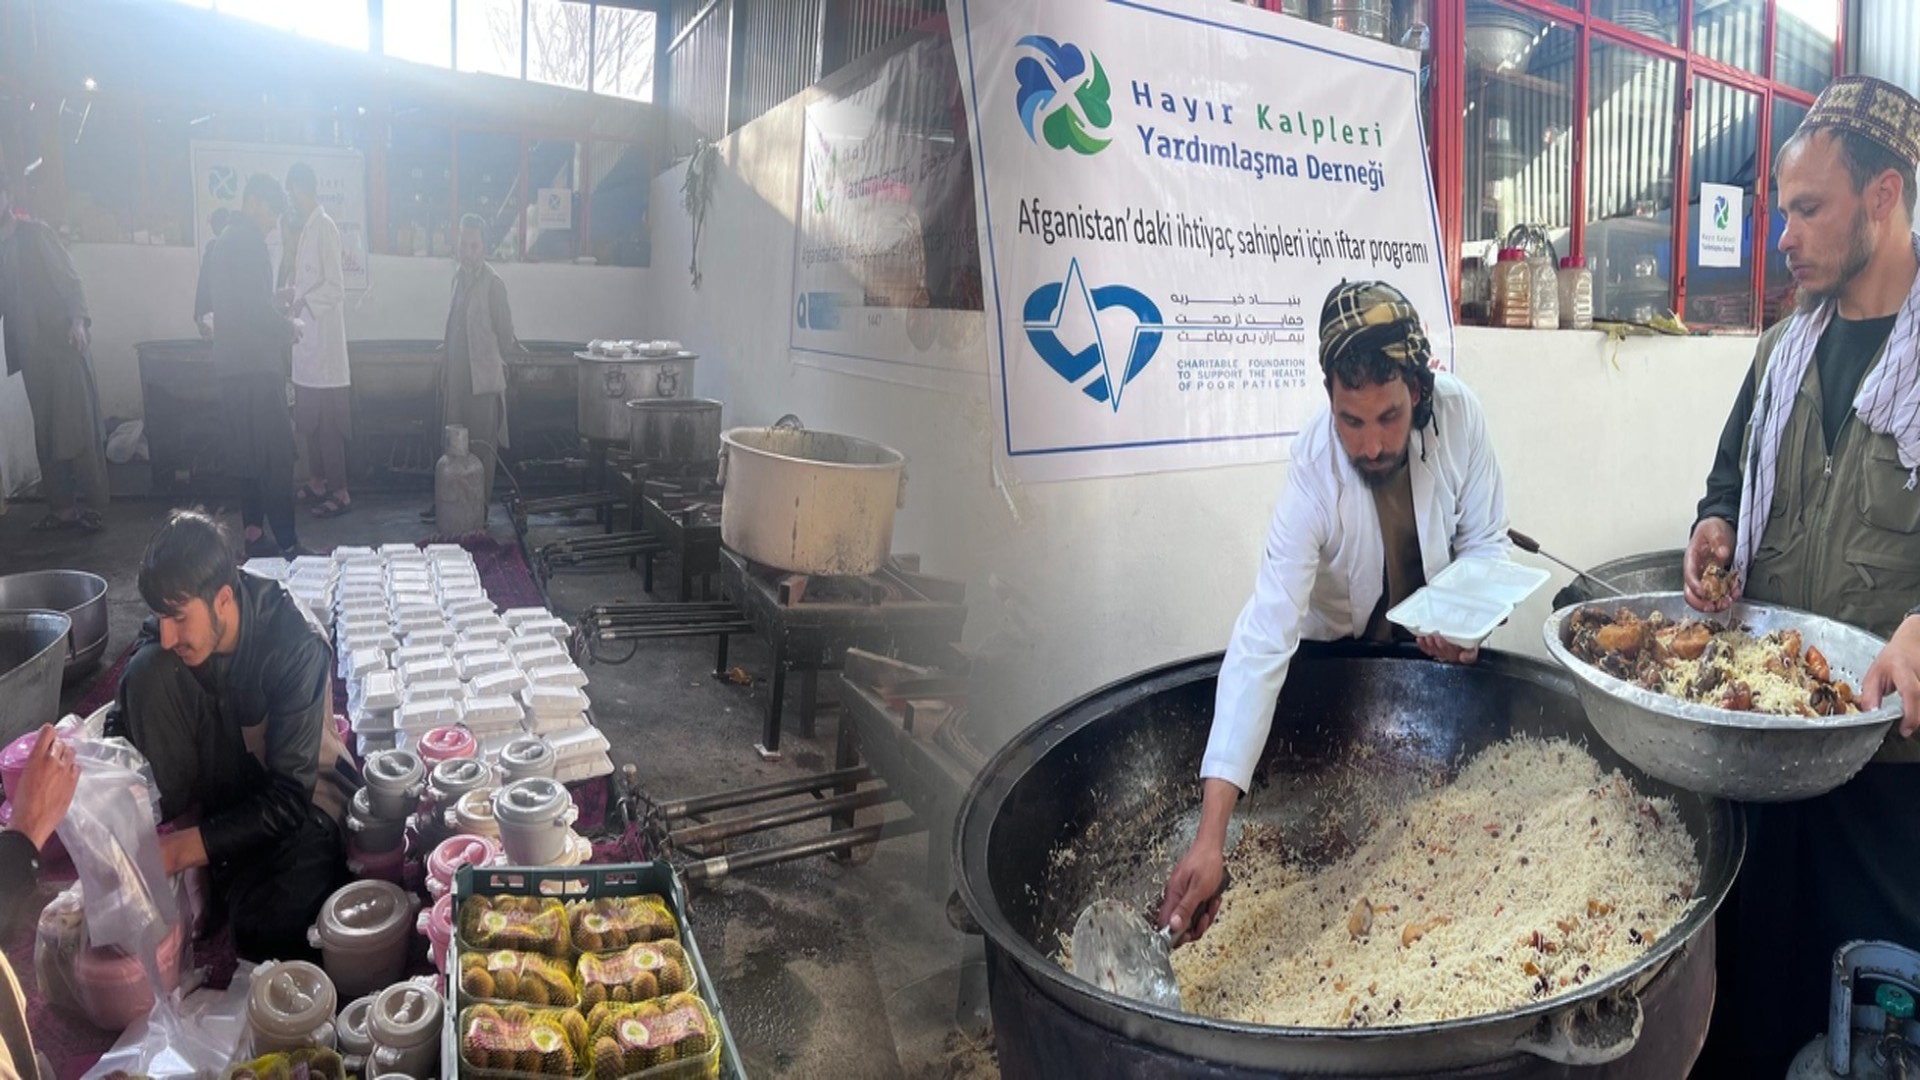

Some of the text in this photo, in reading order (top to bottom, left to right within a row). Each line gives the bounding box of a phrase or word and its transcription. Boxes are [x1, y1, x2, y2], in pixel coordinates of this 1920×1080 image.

[1131, 80, 1383, 148] Hayır Kalpleri
[1137, 124, 1385, 191] Yardımlaşma Derneği
[1176, 215, 1235, 259] ihtiyaç
[1238, 222, 1304, 264] sahipleri
[1307, 229, 1335, 264] için
[1336, 228, 1366, 262] iftar
[1369, 241, 1429, 269] programı
[1177, 358, 1306, 370] CHARITABLE FOUNDATION
[1178, 369, 1306, 380] TO SUPPORT THE HEALTH
[1178, 378, 1306, 391] OF POOR PATIENTS
